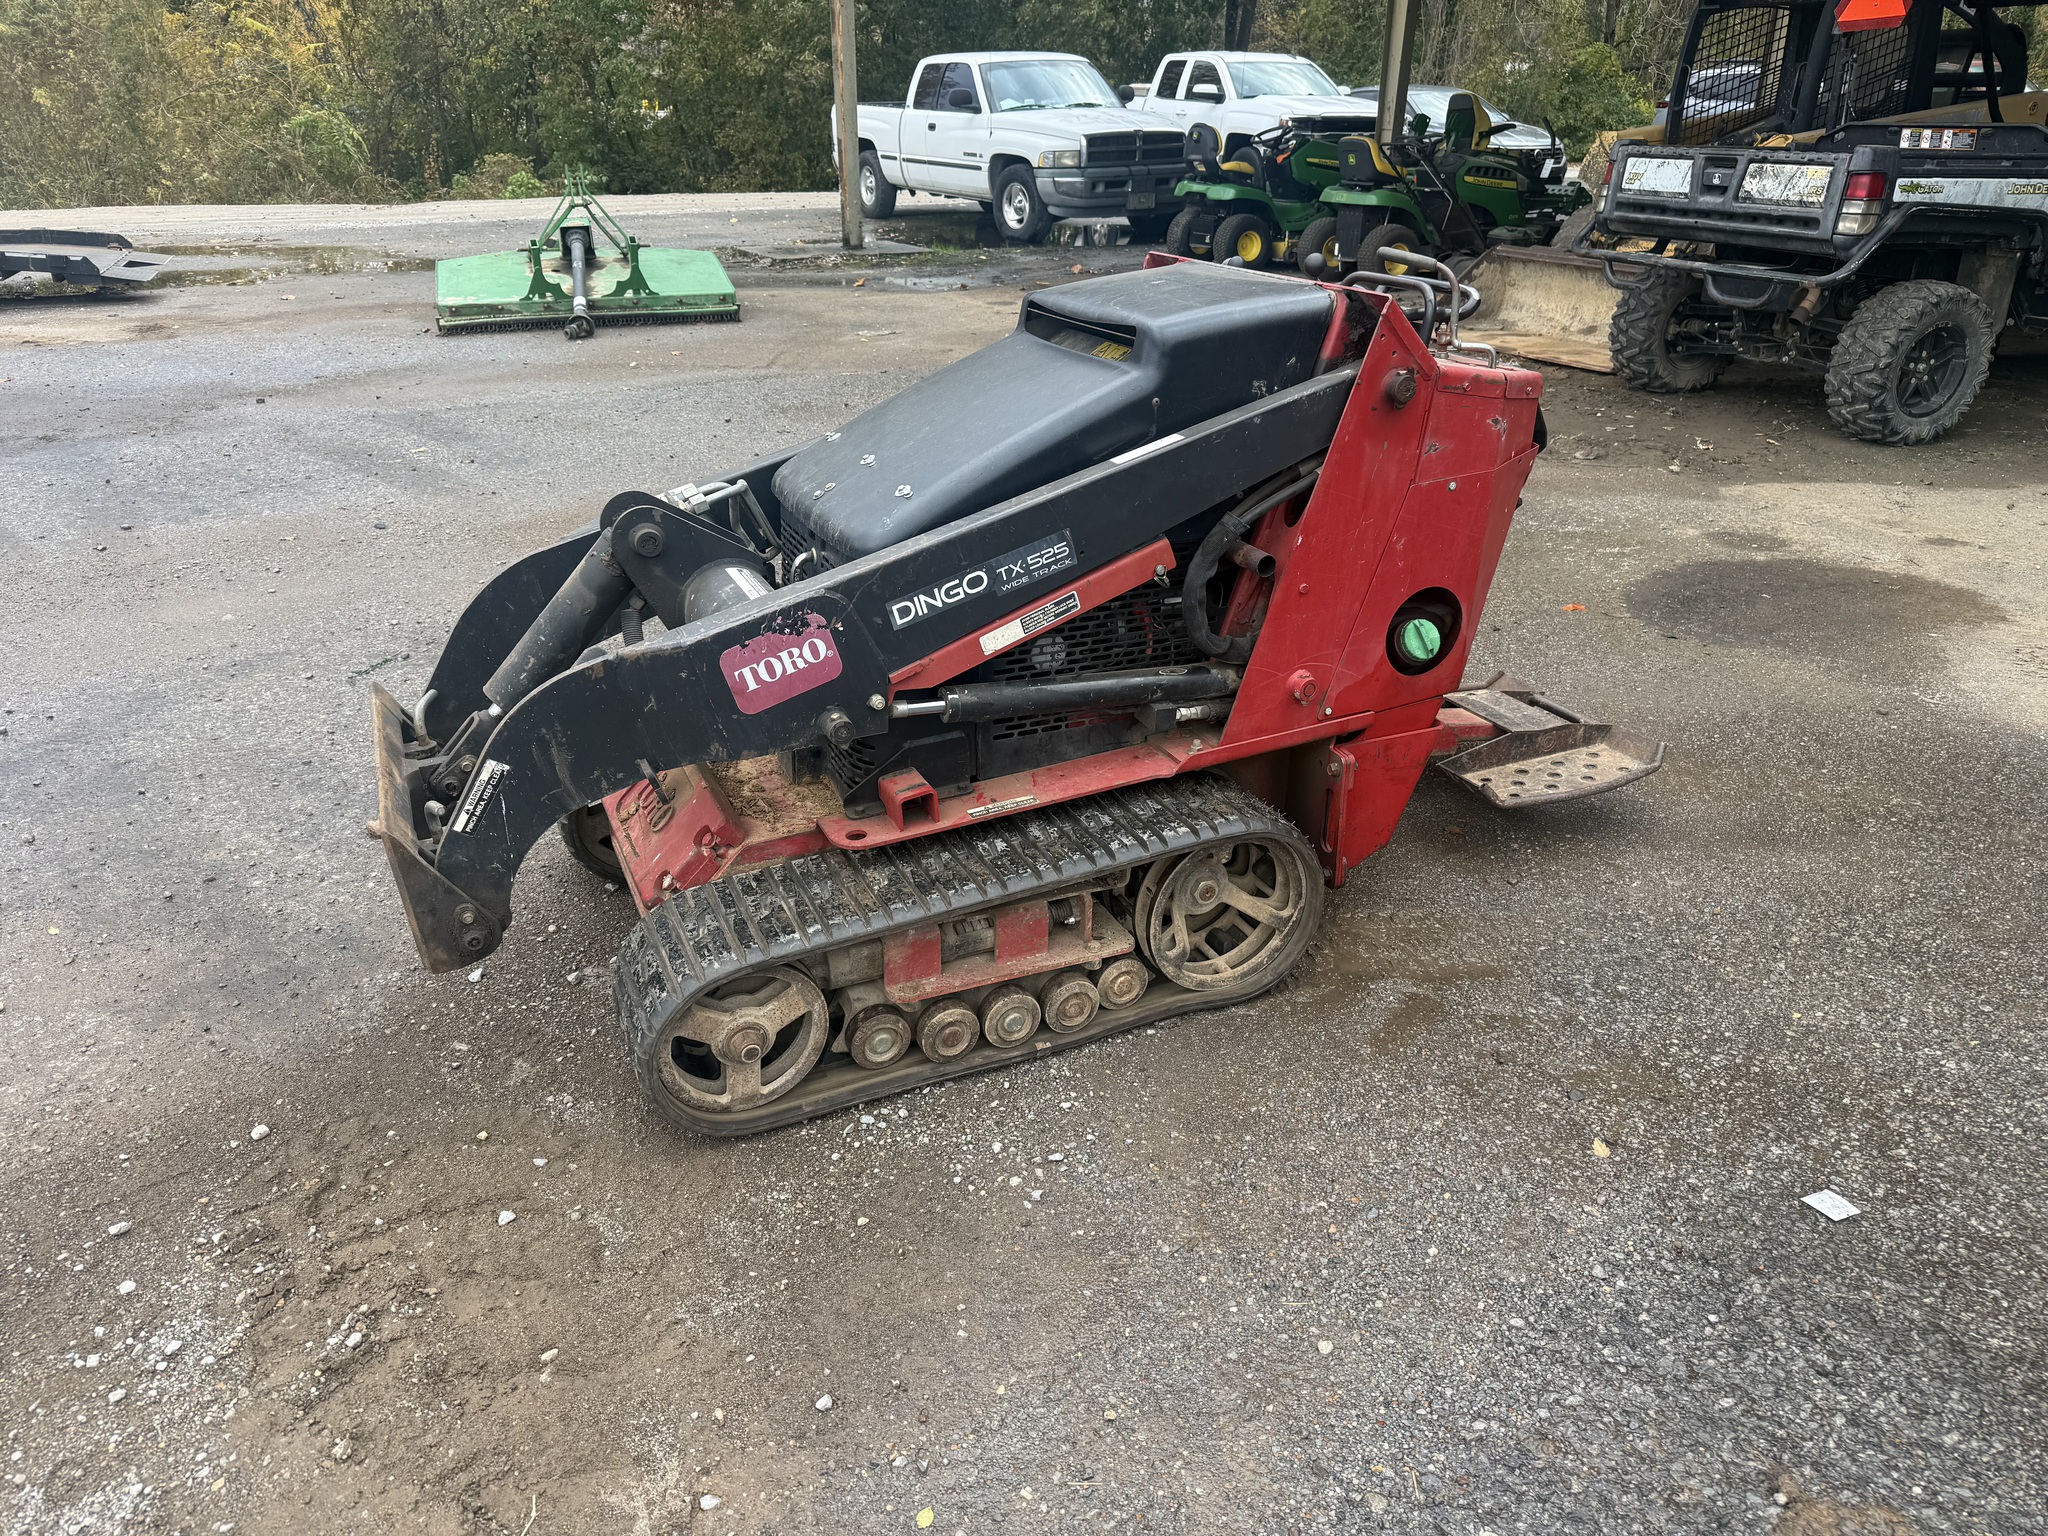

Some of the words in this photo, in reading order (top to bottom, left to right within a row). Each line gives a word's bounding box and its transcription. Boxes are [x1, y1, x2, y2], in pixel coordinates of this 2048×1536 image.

[1917, 184, 1944, 194] GATOR
[2007, 182, 2034, 194] JOHN
[2034, 182, 2048, 195] DE
[1001, 575, 1030, 591] WIDE
[1032, 558, 1072, 578] TRACK
[891, 570, 988, 626] DINGO
[734, 638, 827, 693] TORO
[465, 816, 478, 833] PINCH
[483, 785, 494, 800] KEEP
[467, 779, 486, 807] WARNING
